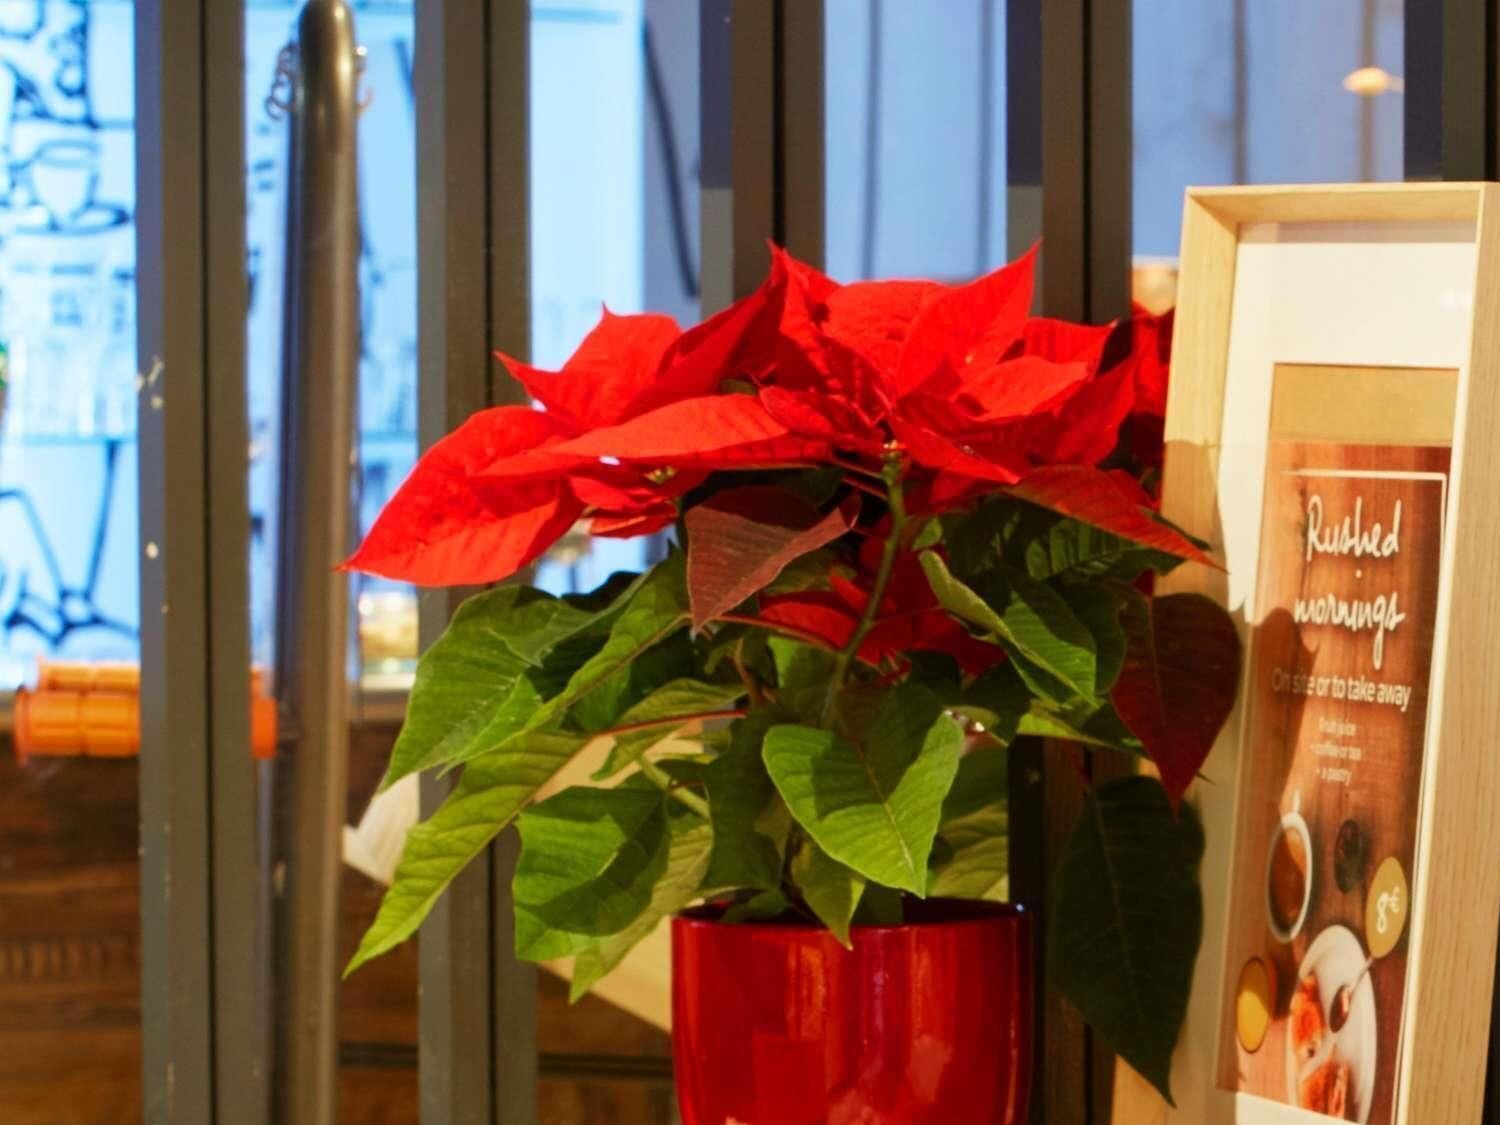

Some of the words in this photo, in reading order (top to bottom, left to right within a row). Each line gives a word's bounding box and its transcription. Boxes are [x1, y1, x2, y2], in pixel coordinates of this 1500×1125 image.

[1306, 495, 1401, 562] Rushed
[1294, 592, 1405, 670] mornings
[1315, 676, 1330, 696] or
[1331, 675, 1346, 699] to
[1347, 675, 1376, 702] take
[1376, 682, 1412, 712] away
